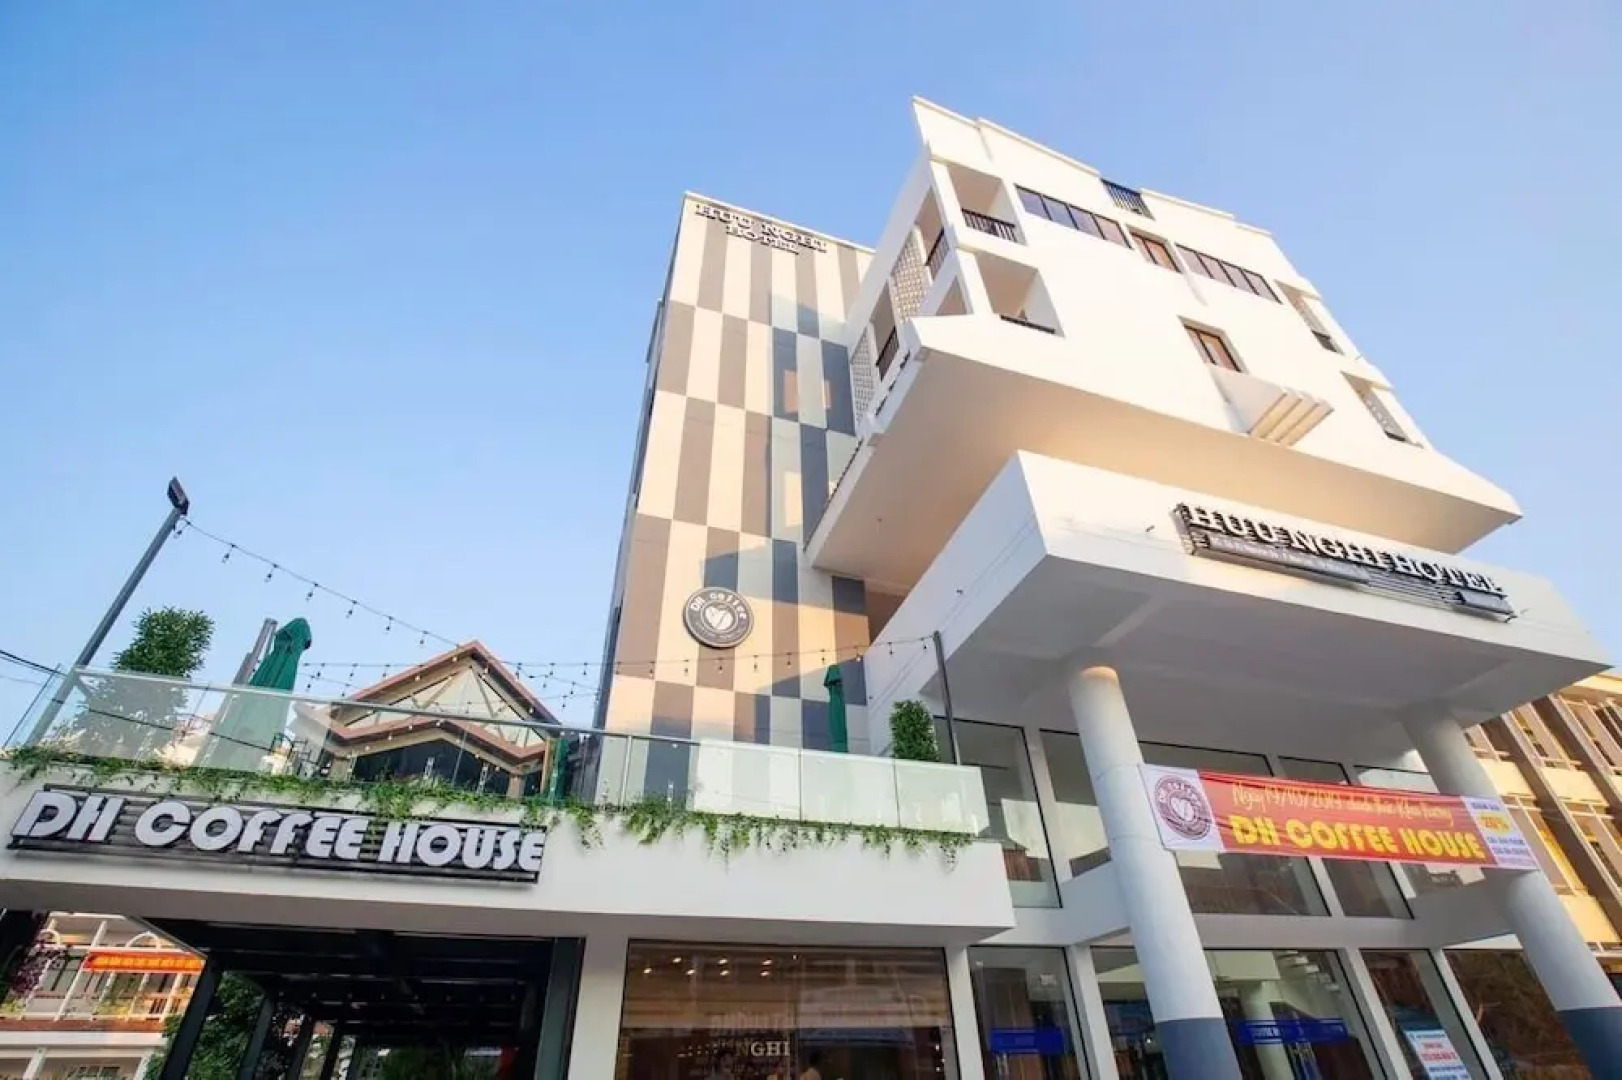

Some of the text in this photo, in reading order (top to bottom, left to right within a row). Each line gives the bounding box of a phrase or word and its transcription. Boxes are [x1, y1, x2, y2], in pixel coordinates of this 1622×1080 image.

[1185, 505, 1280, 543] HUU
[1287, 530, 1388, 570] NGHI
[1389, 554, 1504, 594] HOTEL
[11, 791, 547, 872] DH COFFEE HOUSE
[1229, 814, 1486, 859] DH COFFEE HOUSE
